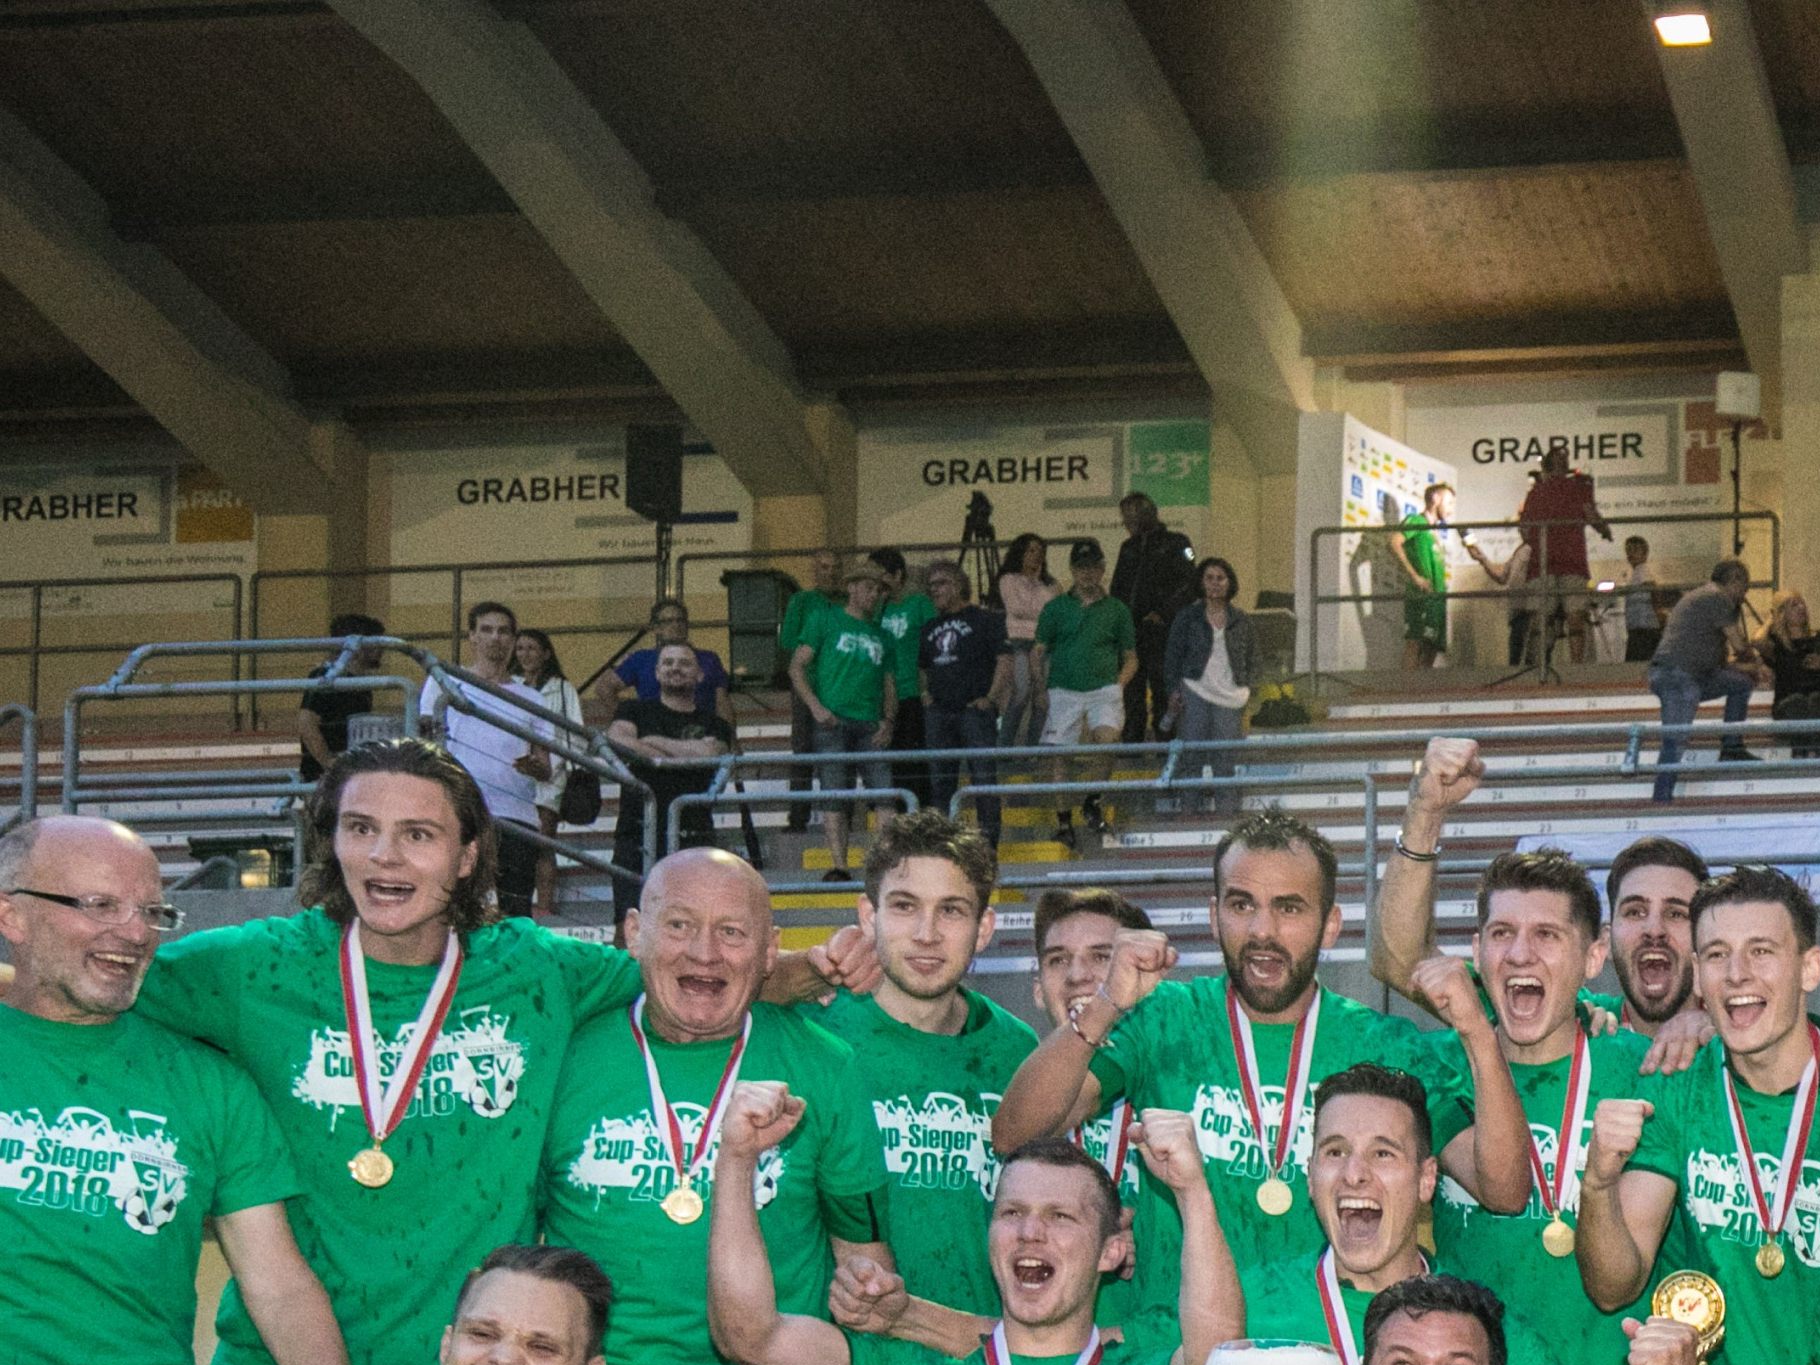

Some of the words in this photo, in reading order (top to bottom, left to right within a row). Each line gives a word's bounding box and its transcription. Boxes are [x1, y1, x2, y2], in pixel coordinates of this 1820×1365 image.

[921, 455, 1089, 487] GRABHER
[1, 492, 138, 521] RABHER
[456, 474, 621, 505] GRABHER
[472, 1056, 512, 1080] SV
[0, 1137, 126, 1175] up-Sieger
[900, 1150, 968, 1191] 2018
[1227, 1139, 1298, 1182] 208
[17, 1164, 111, 1217] 2018
[141, 1168, 179, 1195] SV
[628, 1164, 713, 1203] 208
